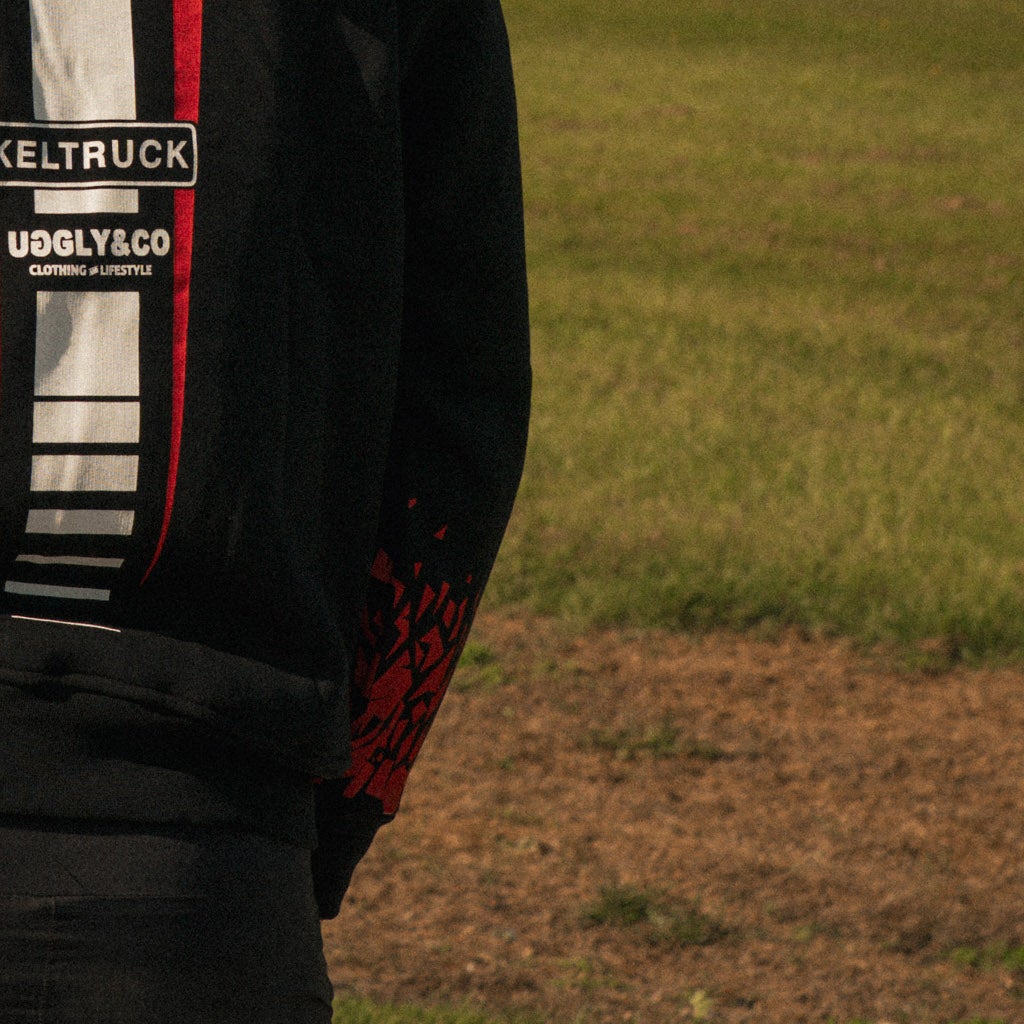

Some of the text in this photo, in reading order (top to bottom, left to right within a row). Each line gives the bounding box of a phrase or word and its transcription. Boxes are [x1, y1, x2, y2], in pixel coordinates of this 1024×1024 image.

[7, 228, 171, 258] UGGLY&CO
[29, 264, 87, 276] CLOTHING
[100, 264, 152, 276] LIFESTYLE
